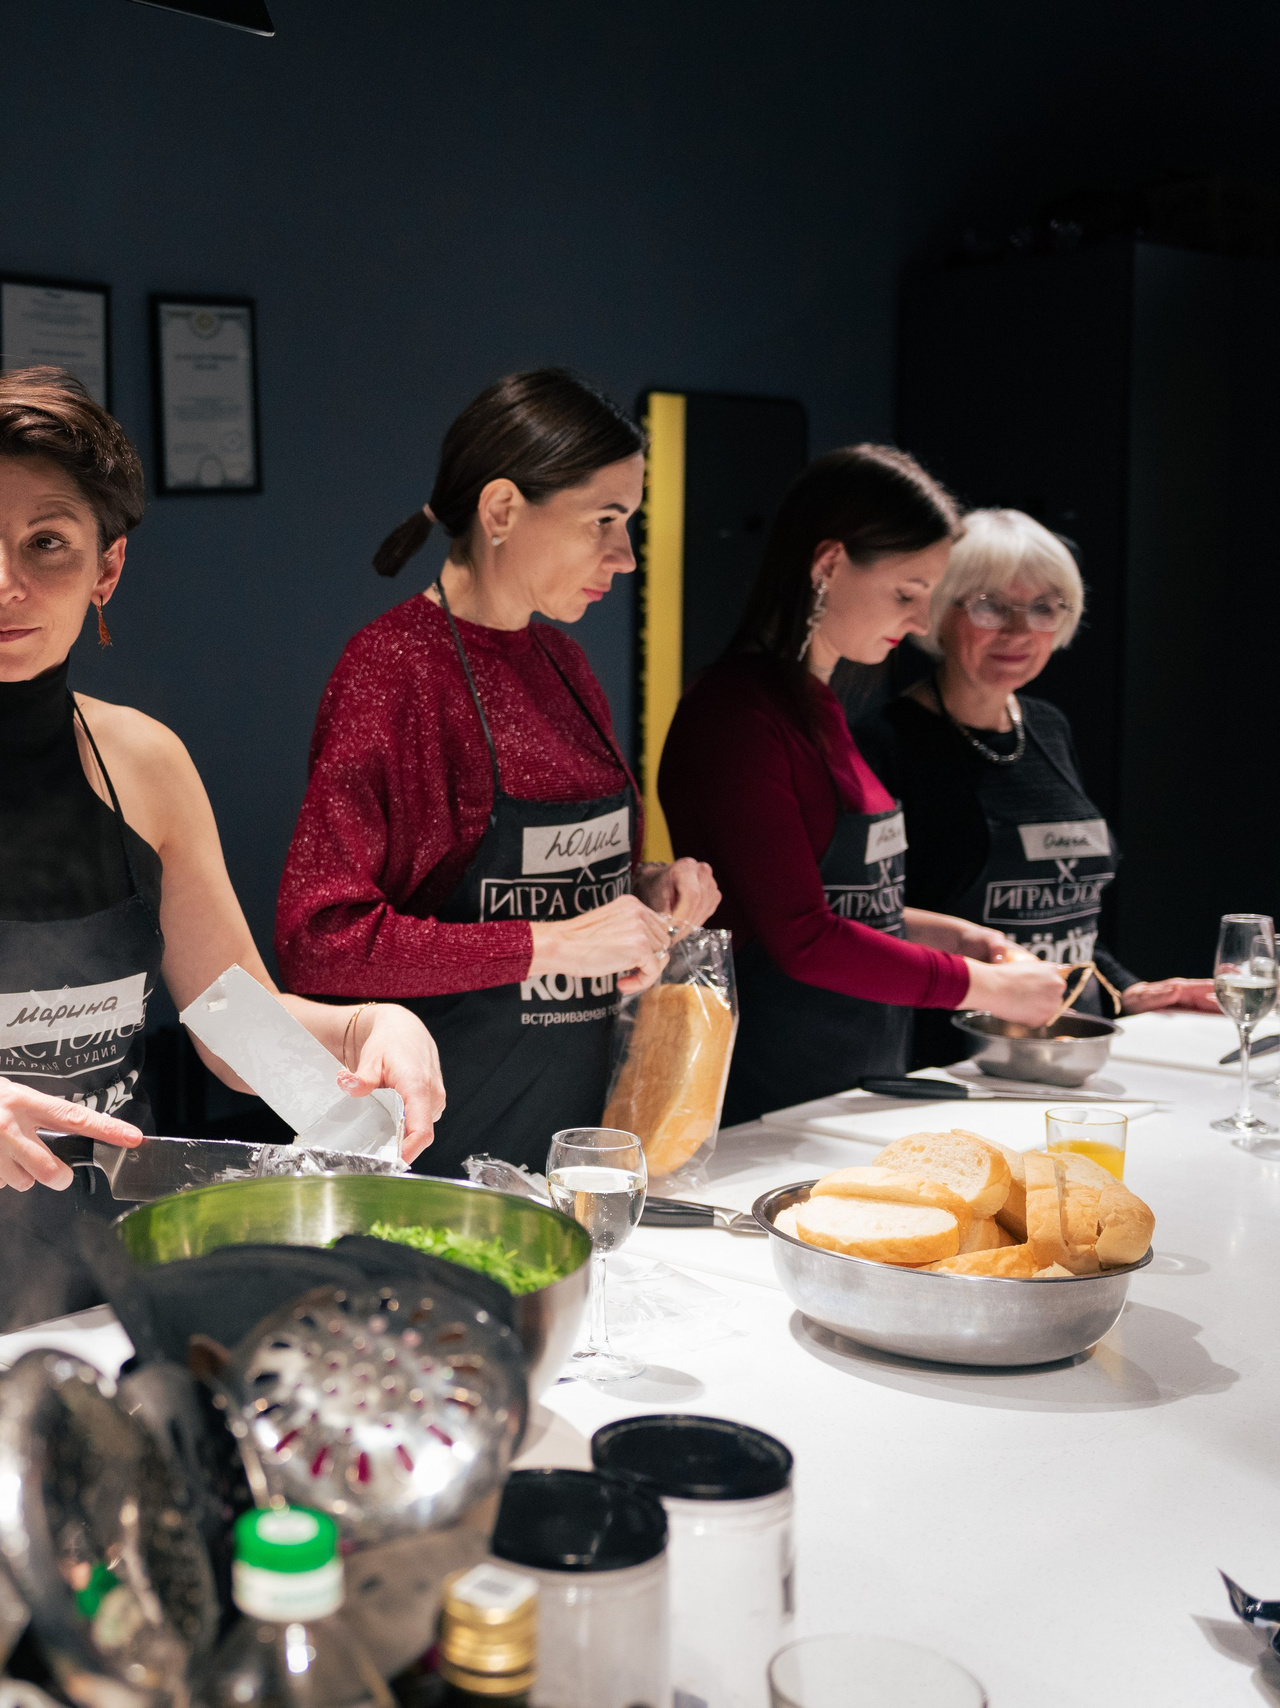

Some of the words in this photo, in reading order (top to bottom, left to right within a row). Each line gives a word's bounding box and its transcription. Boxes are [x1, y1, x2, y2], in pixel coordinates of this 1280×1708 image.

[490, 886, 568, 917] ИГРА
[993, 885, 1055, 910] ИГРА
[6, 995, 119, 1028] Марина
[521, 1008, 607, 1027] встраиваемая
[65, 1044, 118, 1068] СТУДИЯ
